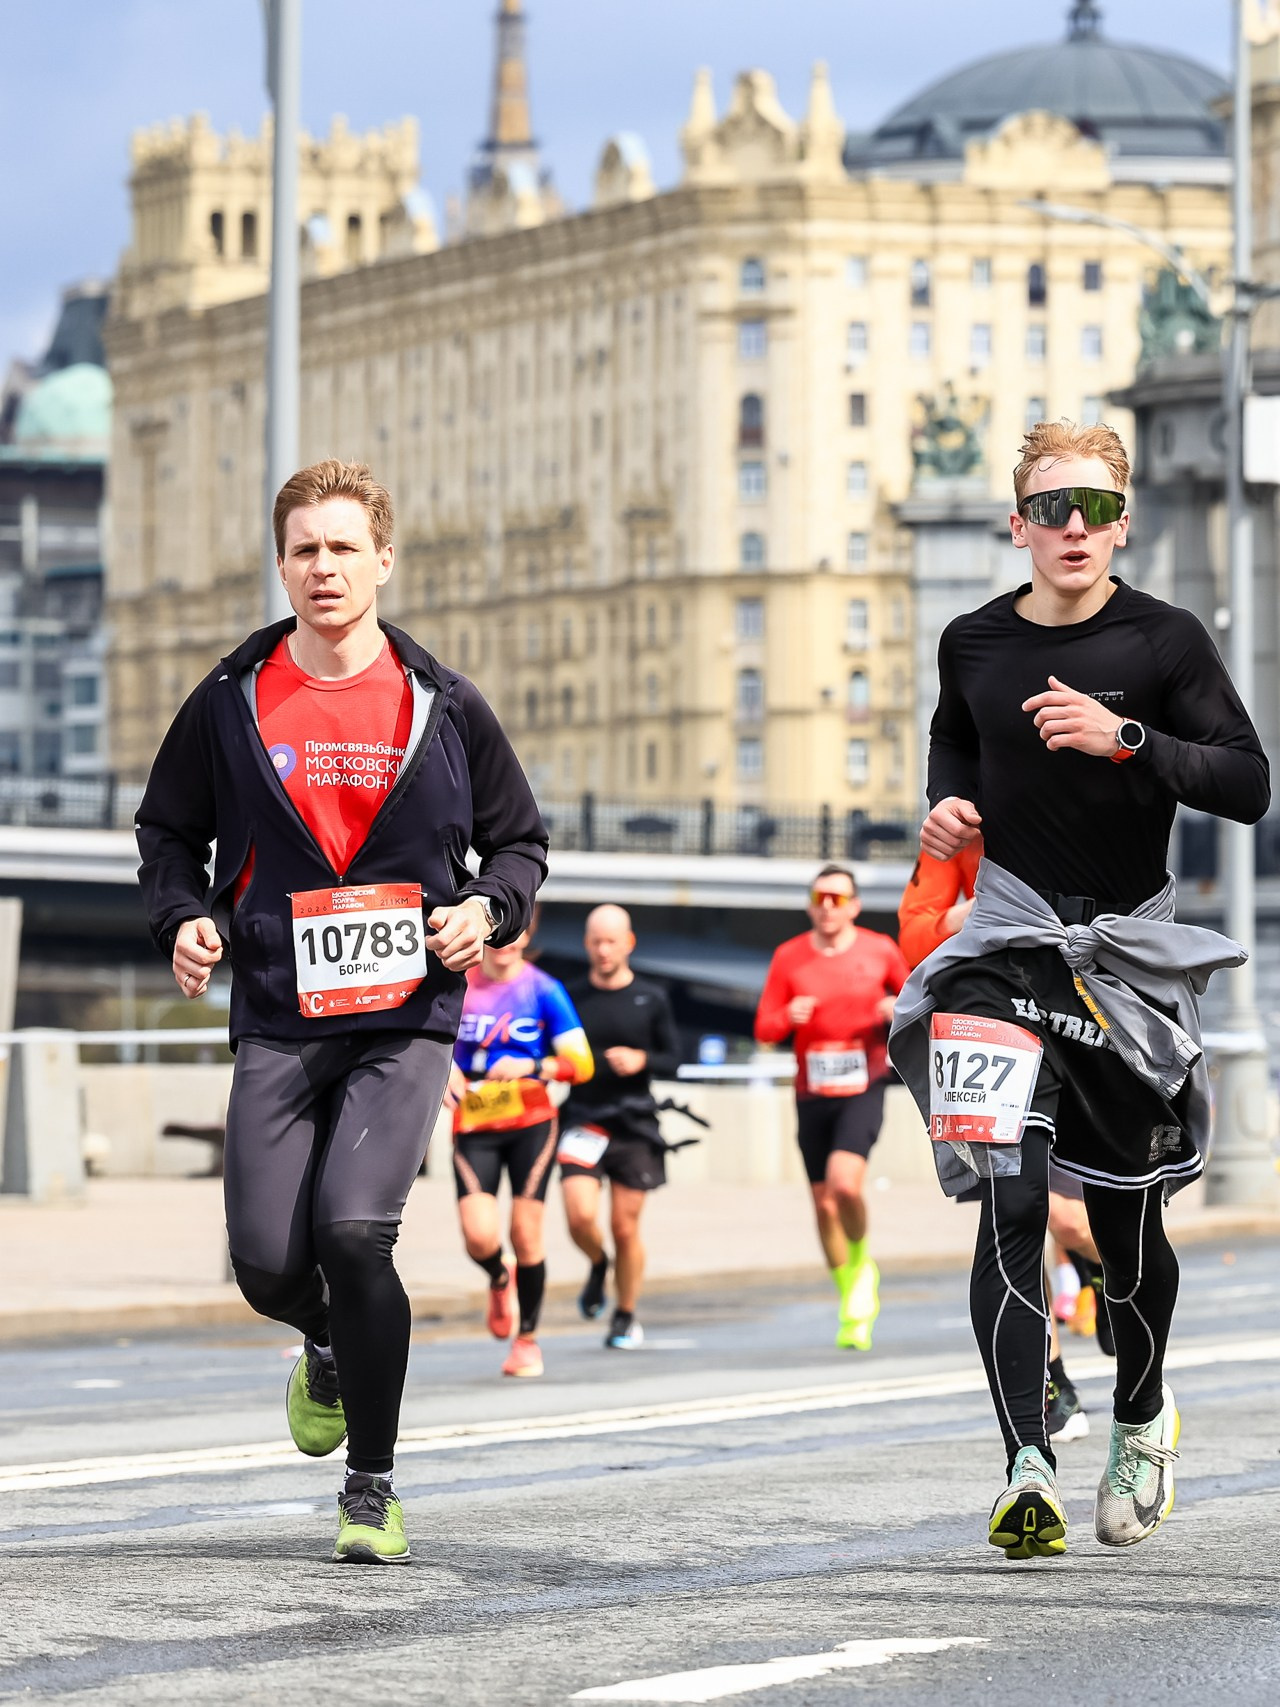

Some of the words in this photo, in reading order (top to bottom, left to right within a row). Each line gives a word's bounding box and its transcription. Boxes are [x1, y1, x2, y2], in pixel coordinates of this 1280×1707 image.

[305, 740, 405, 757] Промсвязьбанк
[307, 773, 388, 790] МАРАФОН
[300, 906, 327, 914] 2026
[301, 919, 418, 965] 10783
[339, 962, 379, 976] БОРИС
[310, 993, 324, 1014] C
[952, 1017, 997, 1029] МОСКОВСКИЙ
[950, 1031, 982, 1039] МАРАФОН
[935, 1051, 1016, 1091] 8127
[944, 1091, 987, 1103] АЛЕКСЕЙ
